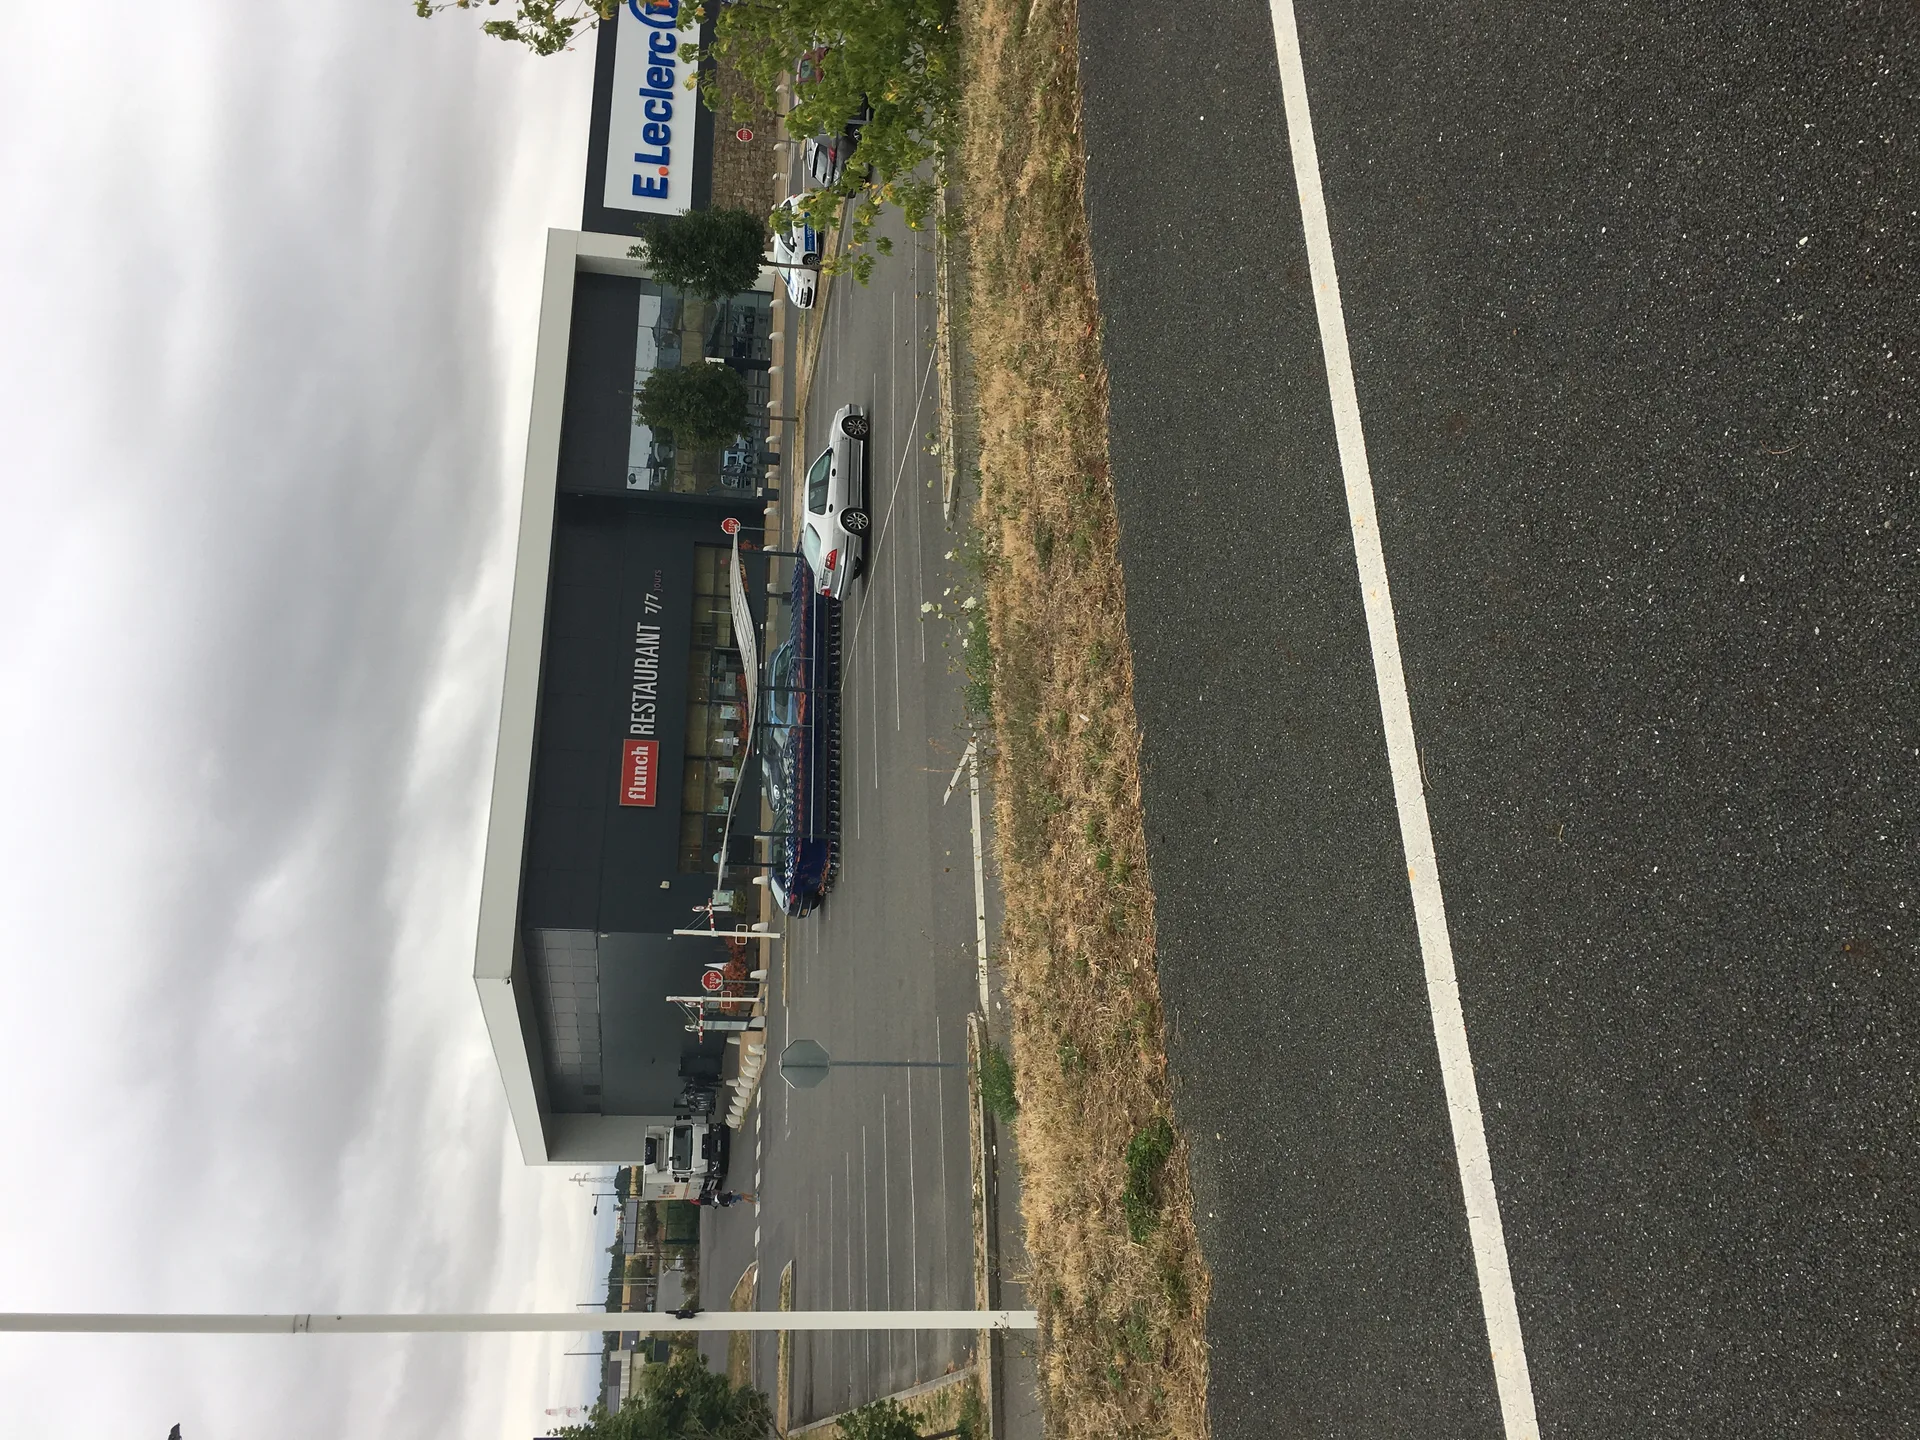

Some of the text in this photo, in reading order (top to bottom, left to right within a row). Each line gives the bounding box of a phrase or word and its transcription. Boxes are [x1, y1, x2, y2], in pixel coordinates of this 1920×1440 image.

[632, 31, 677, 199] E.Leclerc
[728, 520, 736, 532] STOP
[644, 593, 663, 614] 7/7
[630, 622, 660, 735] RESTAURANT
[628, 745, 649, 800] flunch
[709, 972, 717, 989] STOP
